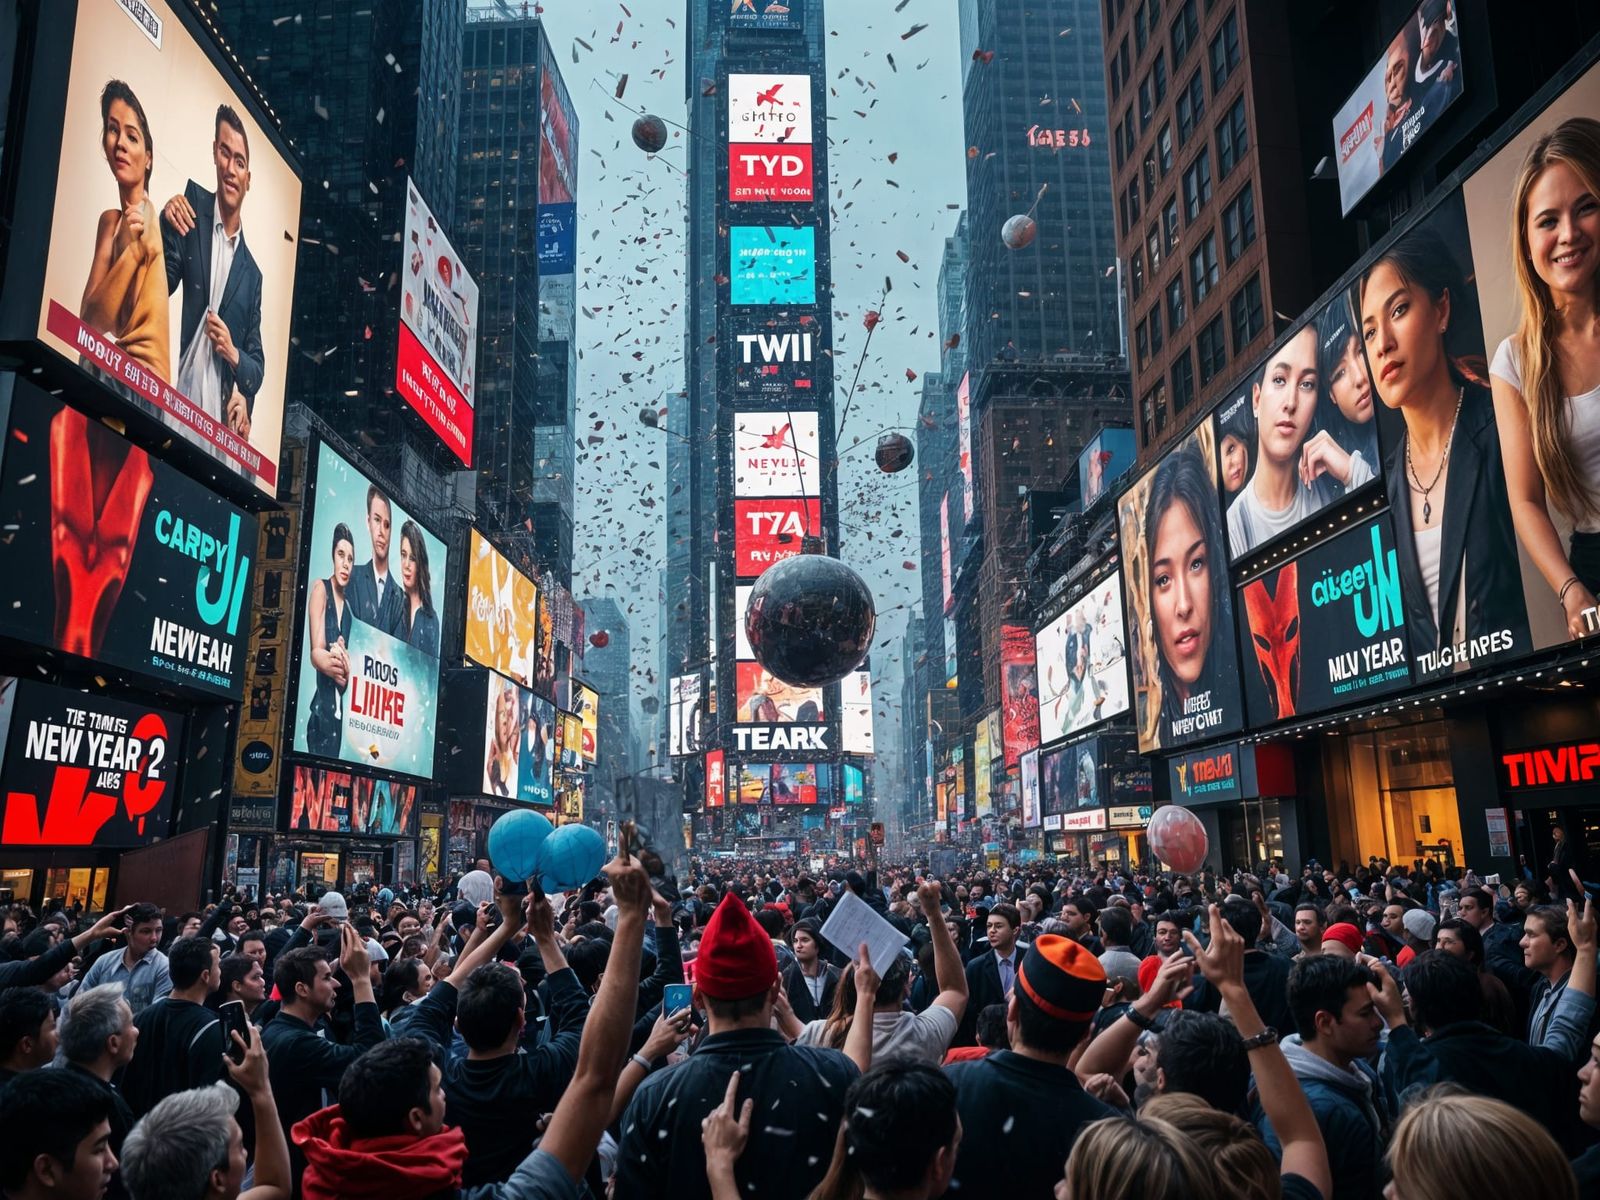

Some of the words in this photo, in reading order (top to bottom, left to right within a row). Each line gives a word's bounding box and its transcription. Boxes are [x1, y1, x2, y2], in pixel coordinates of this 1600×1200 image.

[739, 154, 804, 178] TYD
[1361, 637, 1406, 673] YEAR
[24, 720, 84, 765] NEW
[87, 730, 143, 773] YEAR
[147, 736, 167, 779] 2
[732, 726, 829, 751] TEARK
